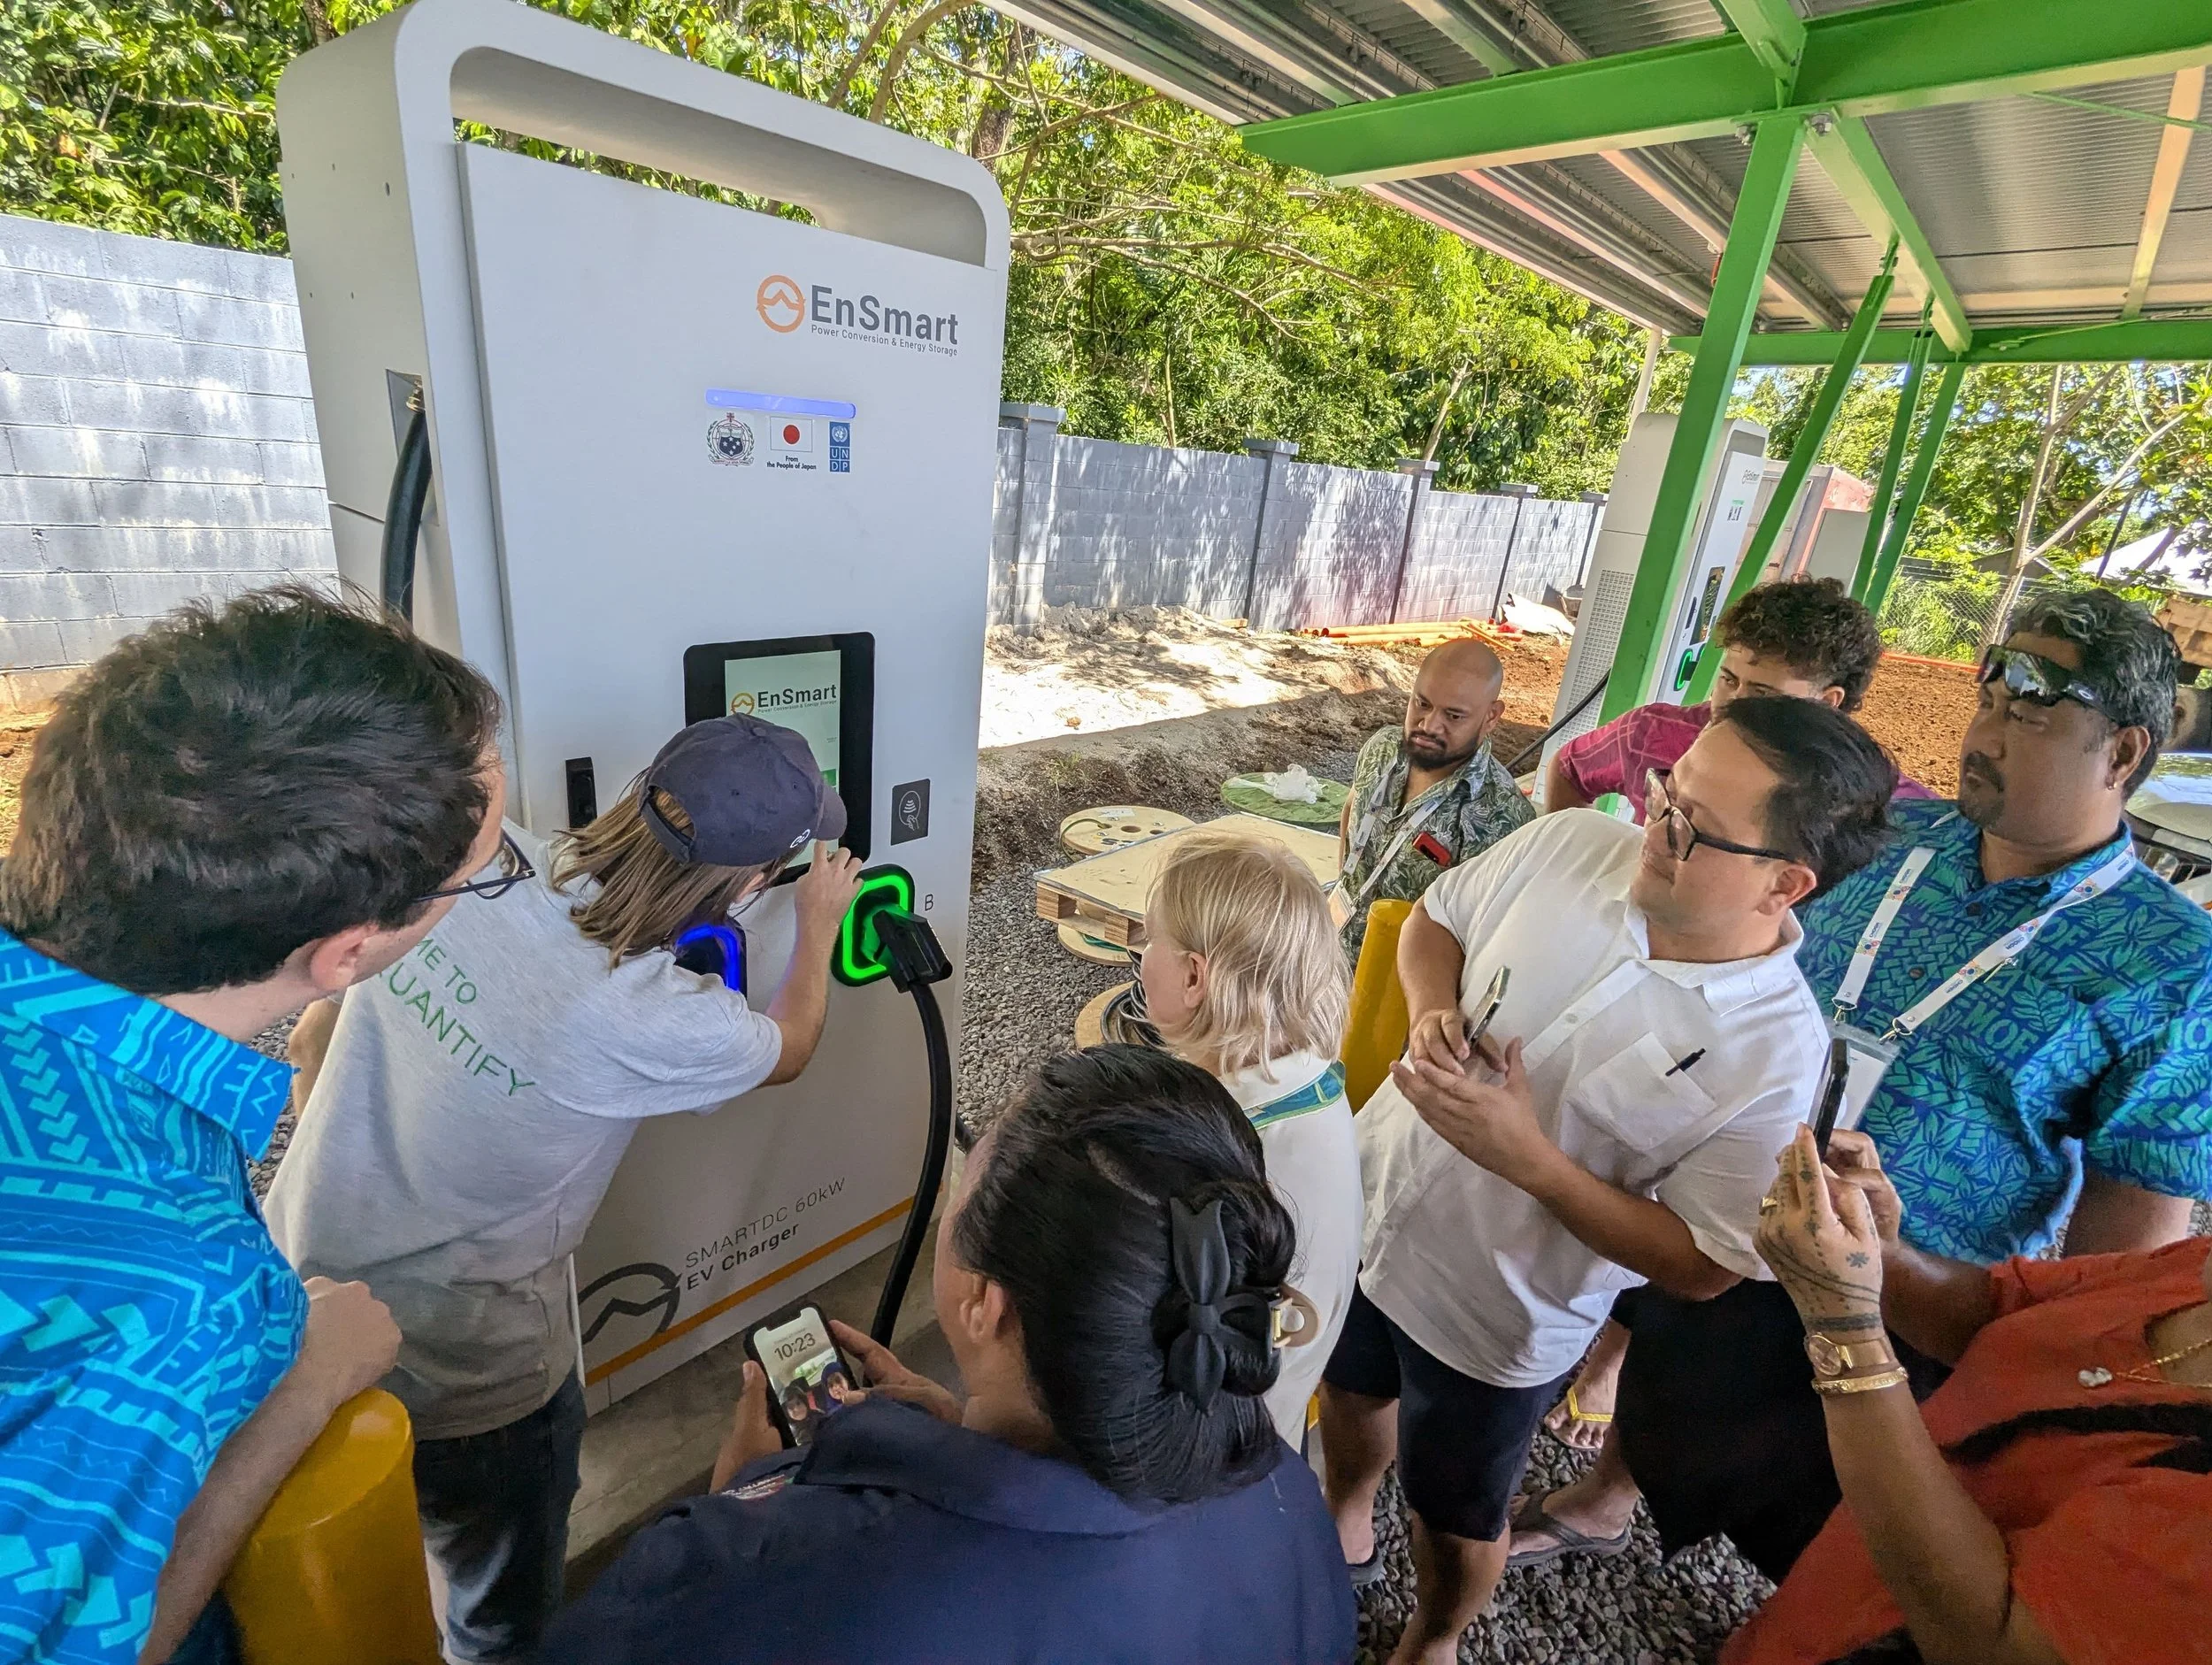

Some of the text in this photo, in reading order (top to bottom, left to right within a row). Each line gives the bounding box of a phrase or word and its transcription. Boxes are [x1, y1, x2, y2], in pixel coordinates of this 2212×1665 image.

[811, 284, 958, 345] EnSmart
[811, 324, 958, 357] Power Conversion & Energy Storage
[758, 684, 837, 708] EnSmart
[925, 894, 933, 911] B
[445, 964, 477, 1004] TO
[380, 963, 535, 1096] UANTIFY
[686, 1177, 845, 1268] SMARTDC 60kW
[687, 1224, 799, 1290] EV Charger
[774, 1332, 816, 1361] 10:23
